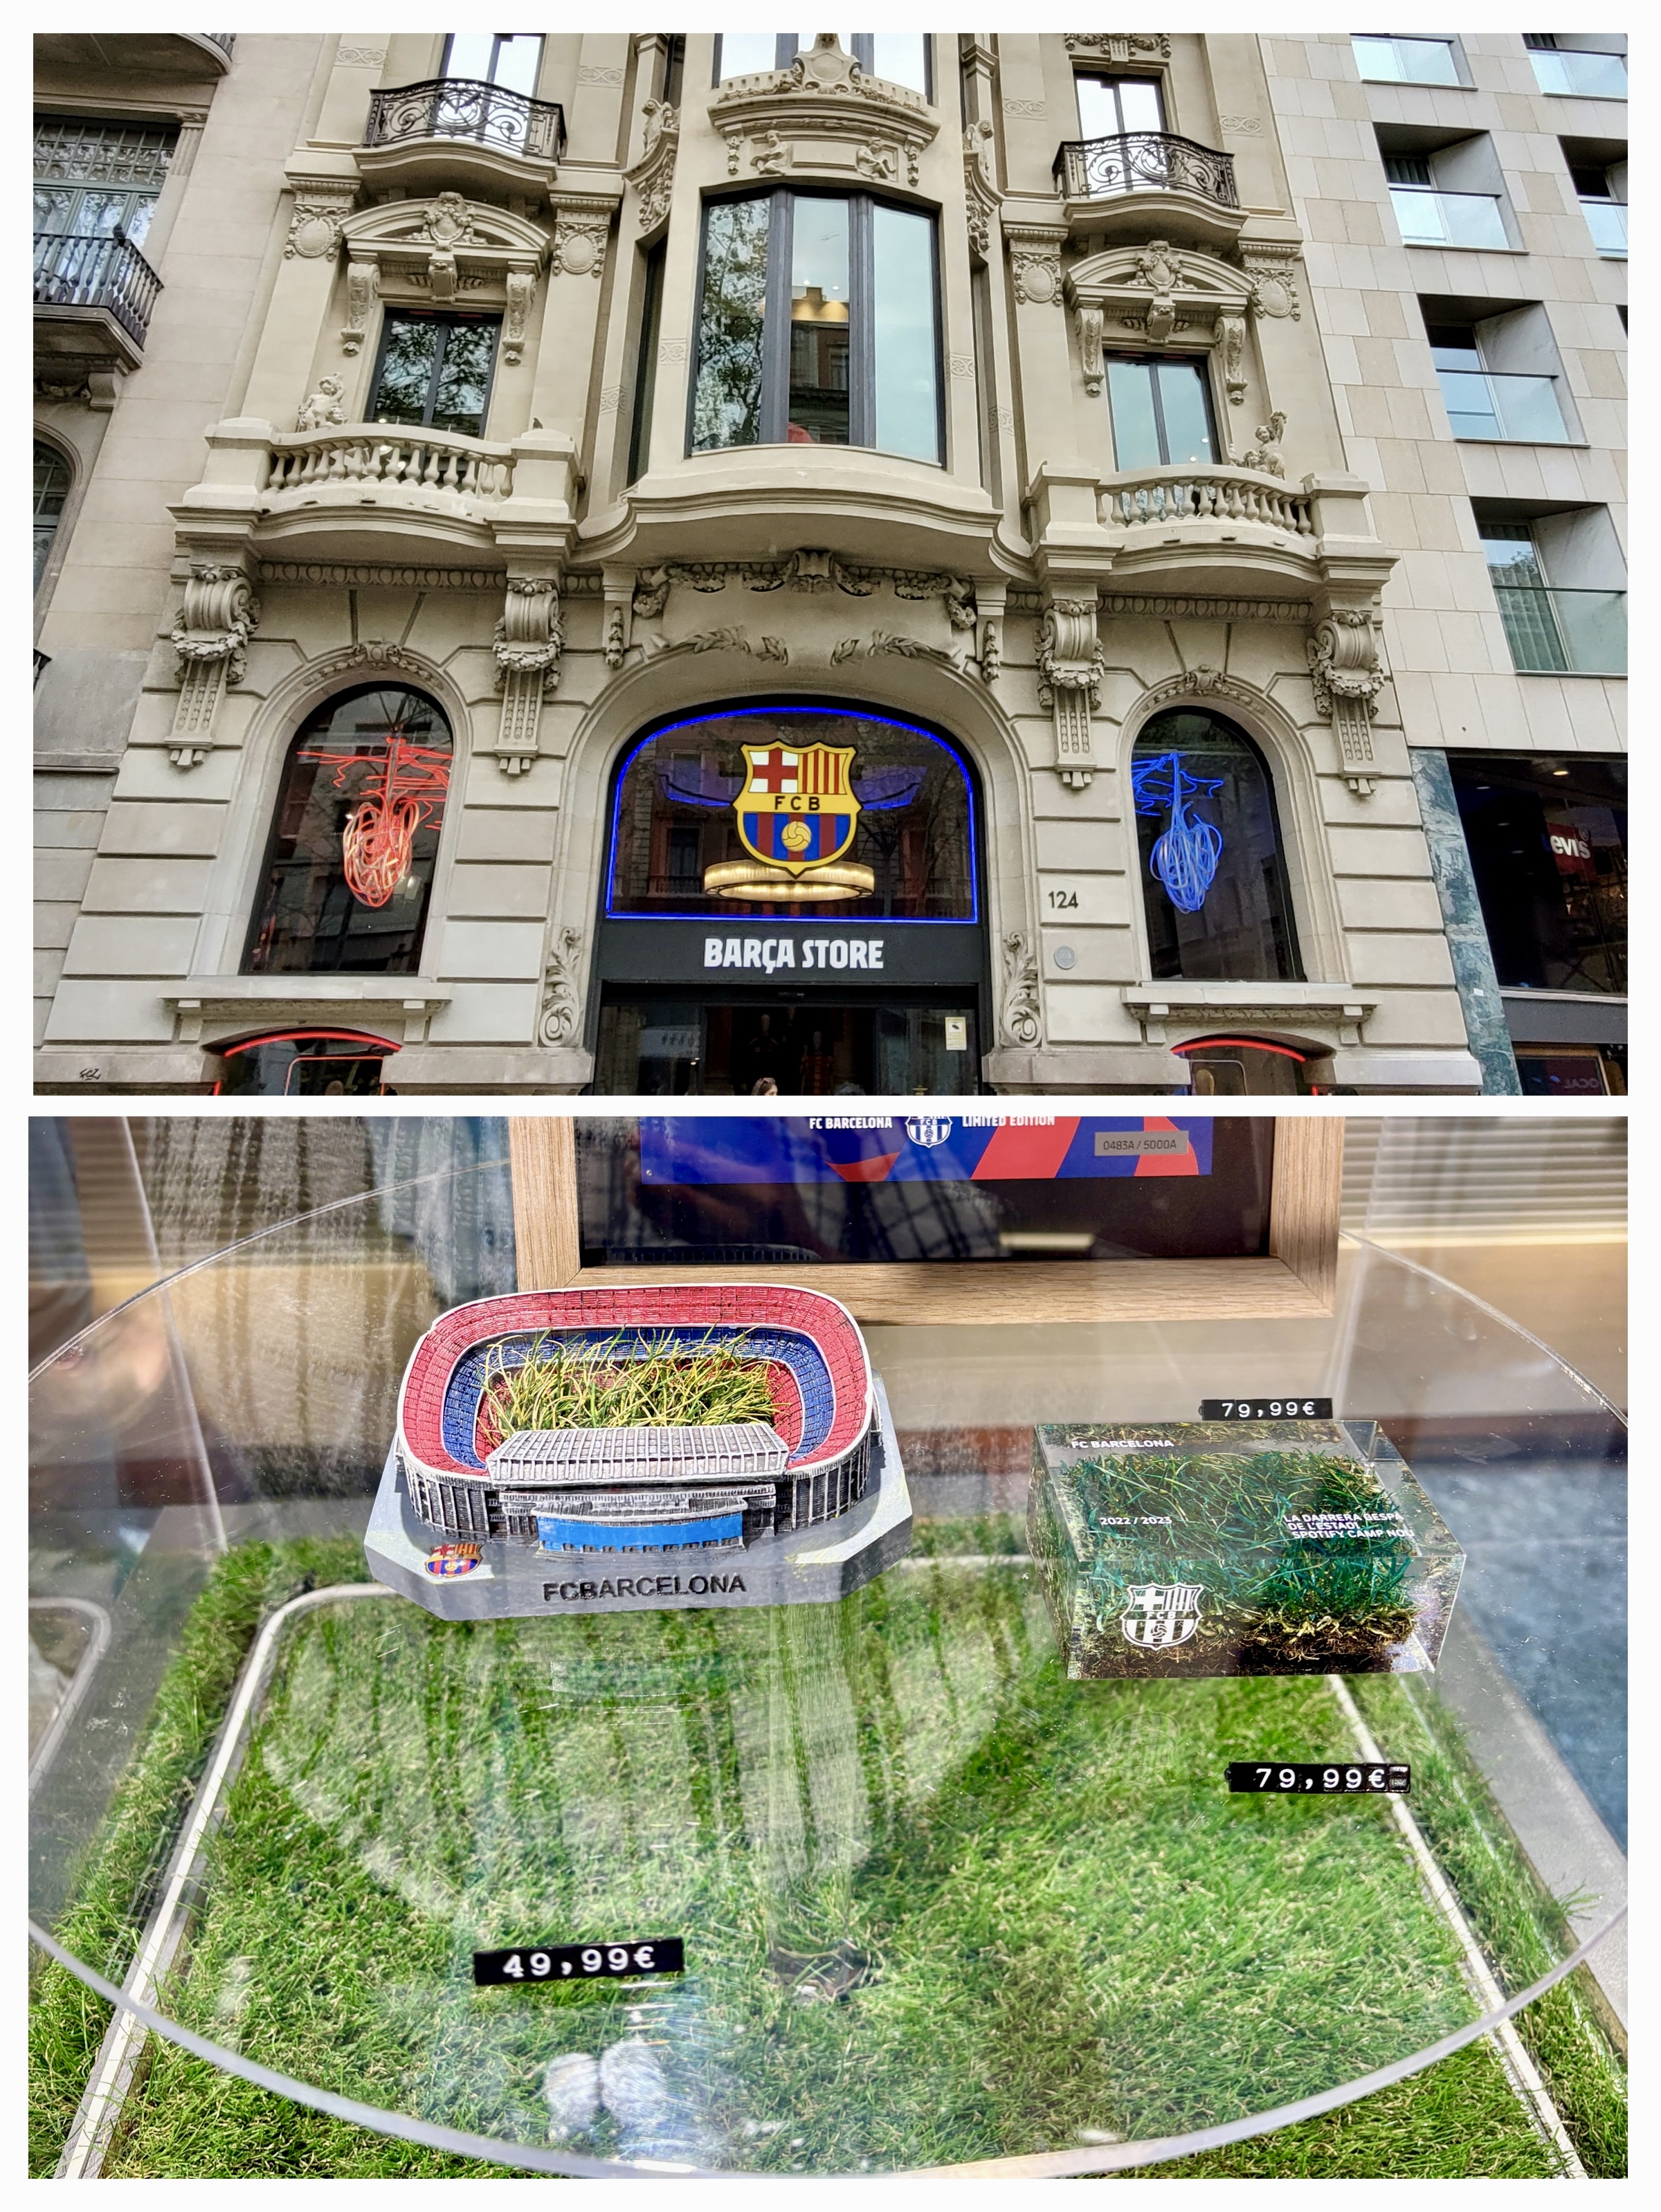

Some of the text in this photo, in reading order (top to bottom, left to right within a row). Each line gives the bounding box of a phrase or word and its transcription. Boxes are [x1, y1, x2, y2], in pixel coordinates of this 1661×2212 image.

[774, 796, 820, 810] FCB
[1048, 891, 1078, 909] 124
[704, 938, 884, 974] BARÇA STORE
[809, 1117, 893, 1130] FC BARCELONA
[962, 1116, 1055, 1127] LIMITED EDITION
[1102, 1141, 1135, 1151] 0483A
[1143, 1139, 1177, 1150] 5000A
[1222, 1402, 1315, 1418] 79,99€
[1091, 1440, 1174, 1449] BARCELONA
[1141, 1516, 1172, 1525] 2023
[1302, 1514, 1363, 1522] DARRERA
[1363, 1513, 1404, 1521] GESPA
[1308, 1522, 1361, 1530] L'ESTADI
[1291, 1529, 1415, 1539] SPOTIFY CAMP NOU
[1255, 1768, 1385, 1790] 79,99€
[502, 1946, 655, 1978] 49,99€
